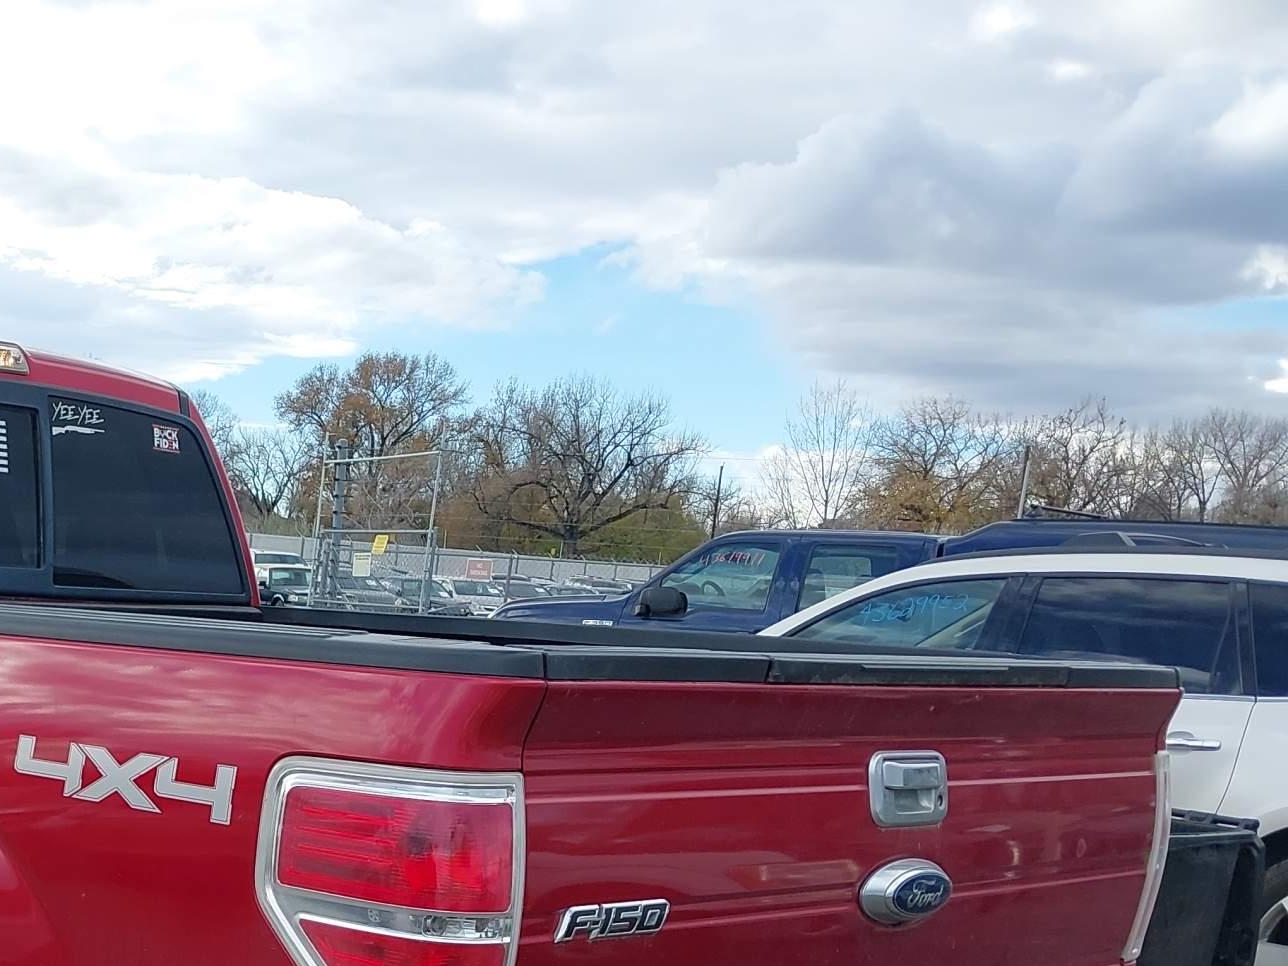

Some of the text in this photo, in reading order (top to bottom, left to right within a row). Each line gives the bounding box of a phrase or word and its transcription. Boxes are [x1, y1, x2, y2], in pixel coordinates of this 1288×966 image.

[52, 401, 104, 425] YEE YEE
[14, 734, 237, 825] 4X4
[907, 879, 944, 908] Ford
